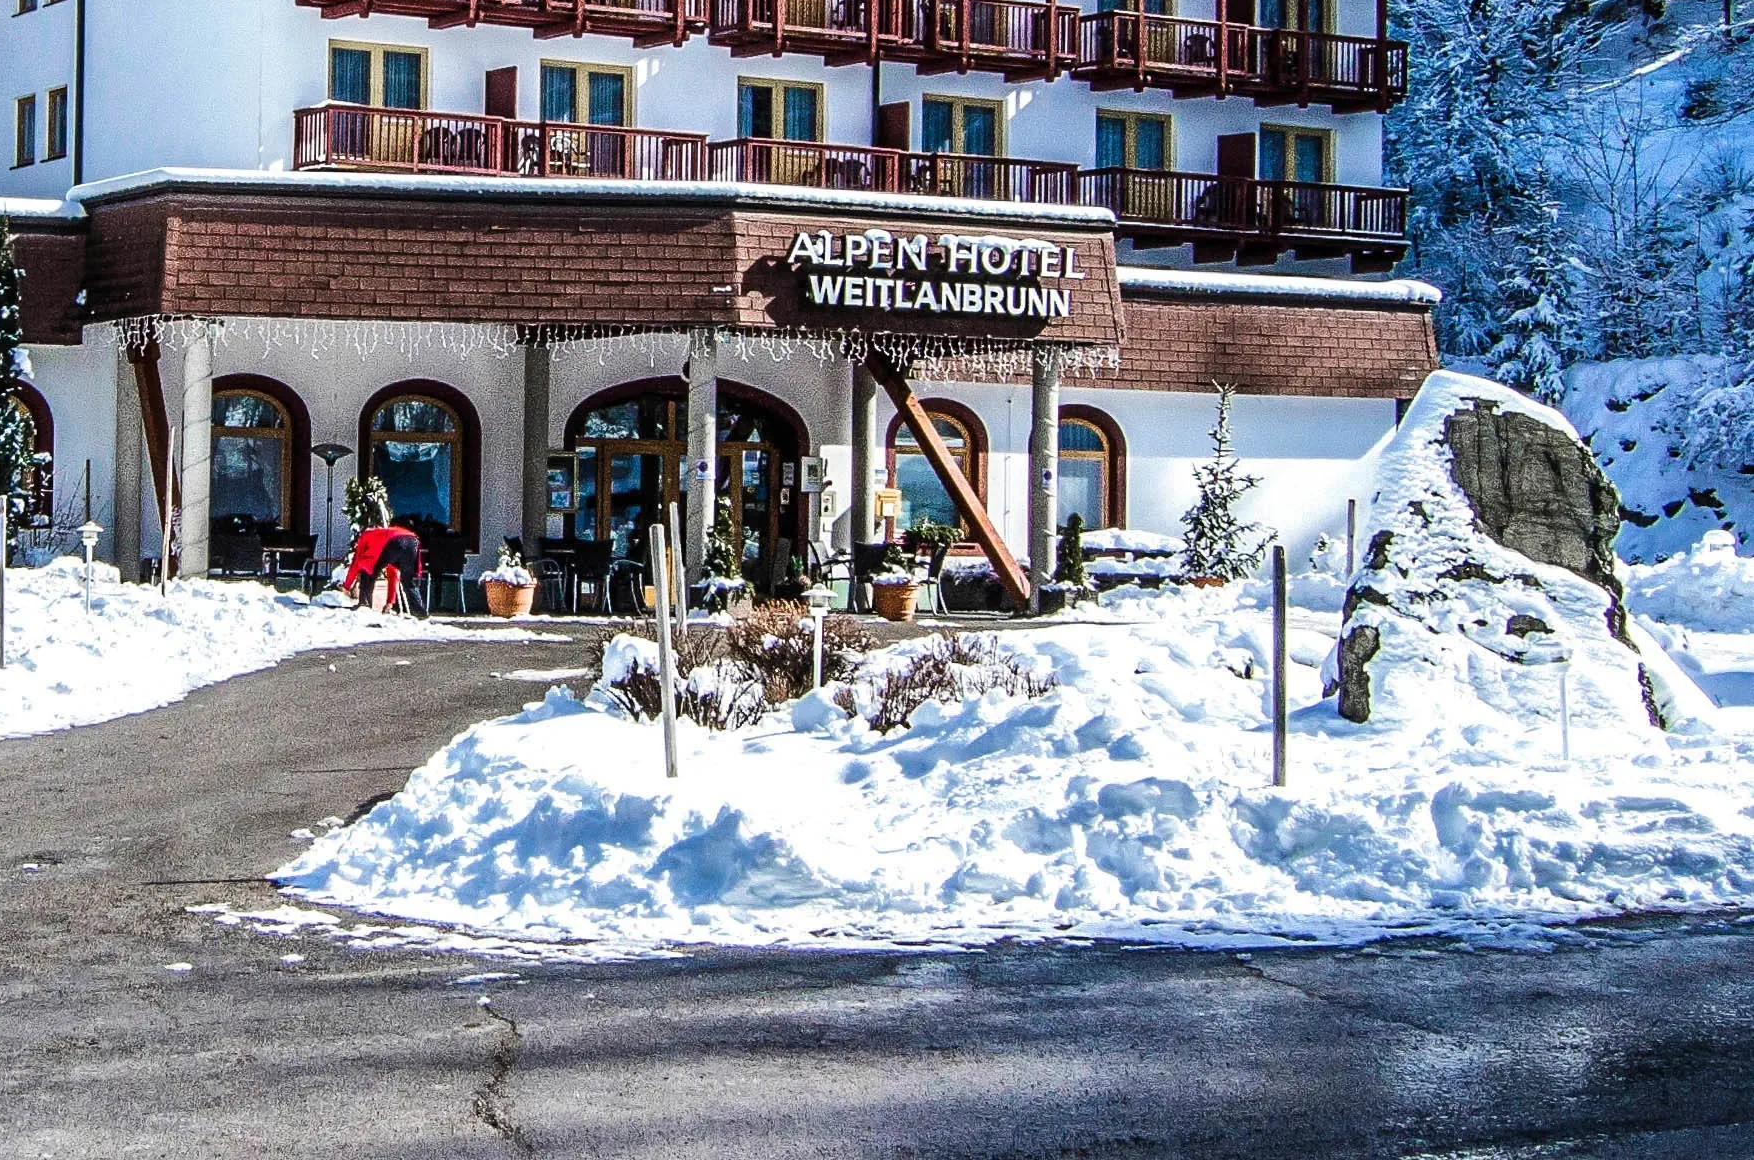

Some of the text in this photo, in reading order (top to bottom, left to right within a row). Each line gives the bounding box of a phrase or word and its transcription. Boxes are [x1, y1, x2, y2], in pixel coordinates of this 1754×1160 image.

[787, 231, 1086, 279] ALPEN HOTEL
[809, 275, 1072, 318] WEITLANBRUNN
